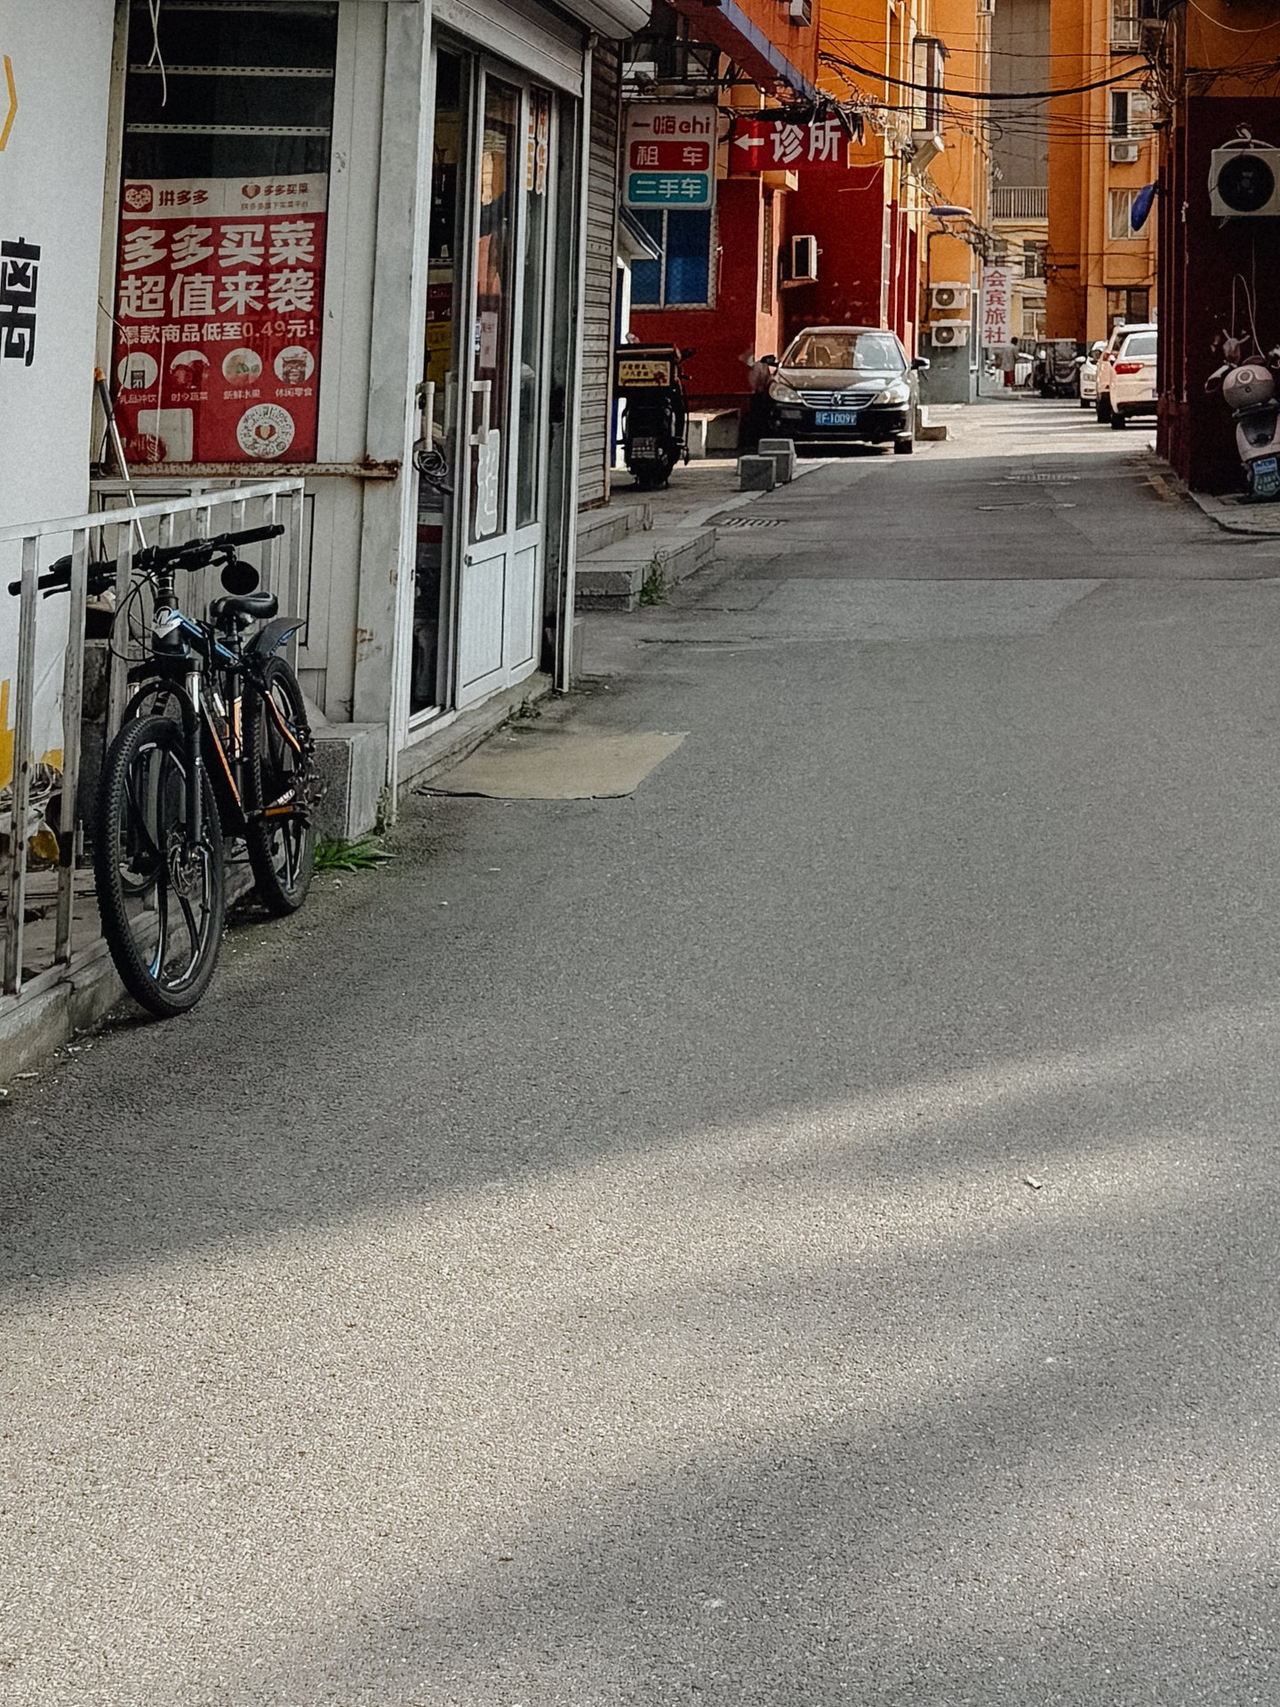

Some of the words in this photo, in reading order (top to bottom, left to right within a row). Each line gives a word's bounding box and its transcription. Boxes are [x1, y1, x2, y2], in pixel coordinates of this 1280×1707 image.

[770, 119, 842, 164] 诊所
[636, 145, 703, 166] 租车
[159, 189, 209, 206] 拼多多
[264, 183, 309, 196] 多多买菜
[635, 177, 702, 199] 二手车
[122, 220, 315, 272] 多多买菜
[118, 268, 315, 319] 超值来袭
[985, 270, 1006, 344] 会宾旅社
[223, 389, 261, 400] 新鲜水果
[275, 387, 313, 398] 休闲零食
